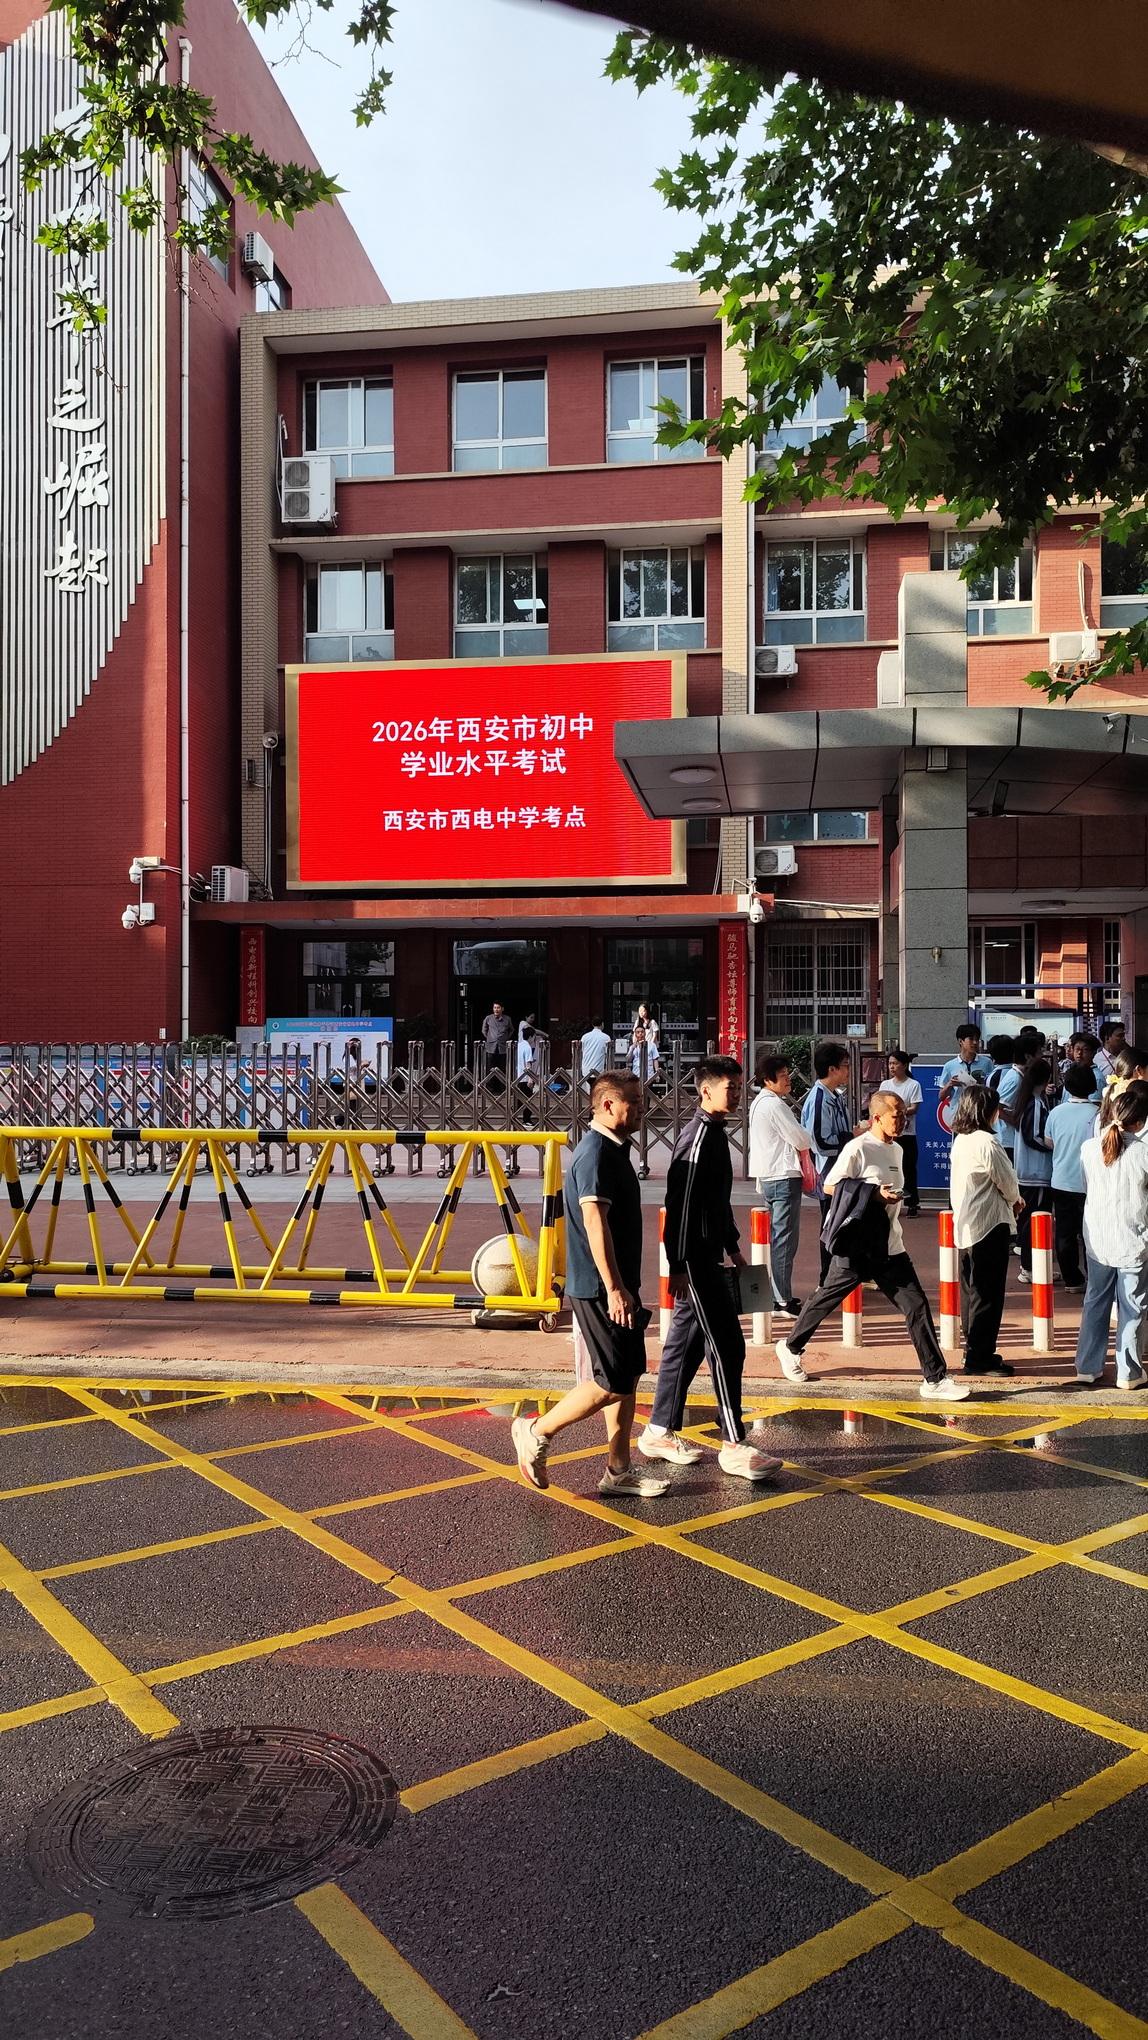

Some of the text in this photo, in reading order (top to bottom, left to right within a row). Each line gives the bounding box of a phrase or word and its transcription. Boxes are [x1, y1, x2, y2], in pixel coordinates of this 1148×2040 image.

[372, 712, 592, 743] 2026年西安市初中
[400, 747, 566, 777] 学业水平考试
[382, 805, 585, 830] 西安市西电中学考点
